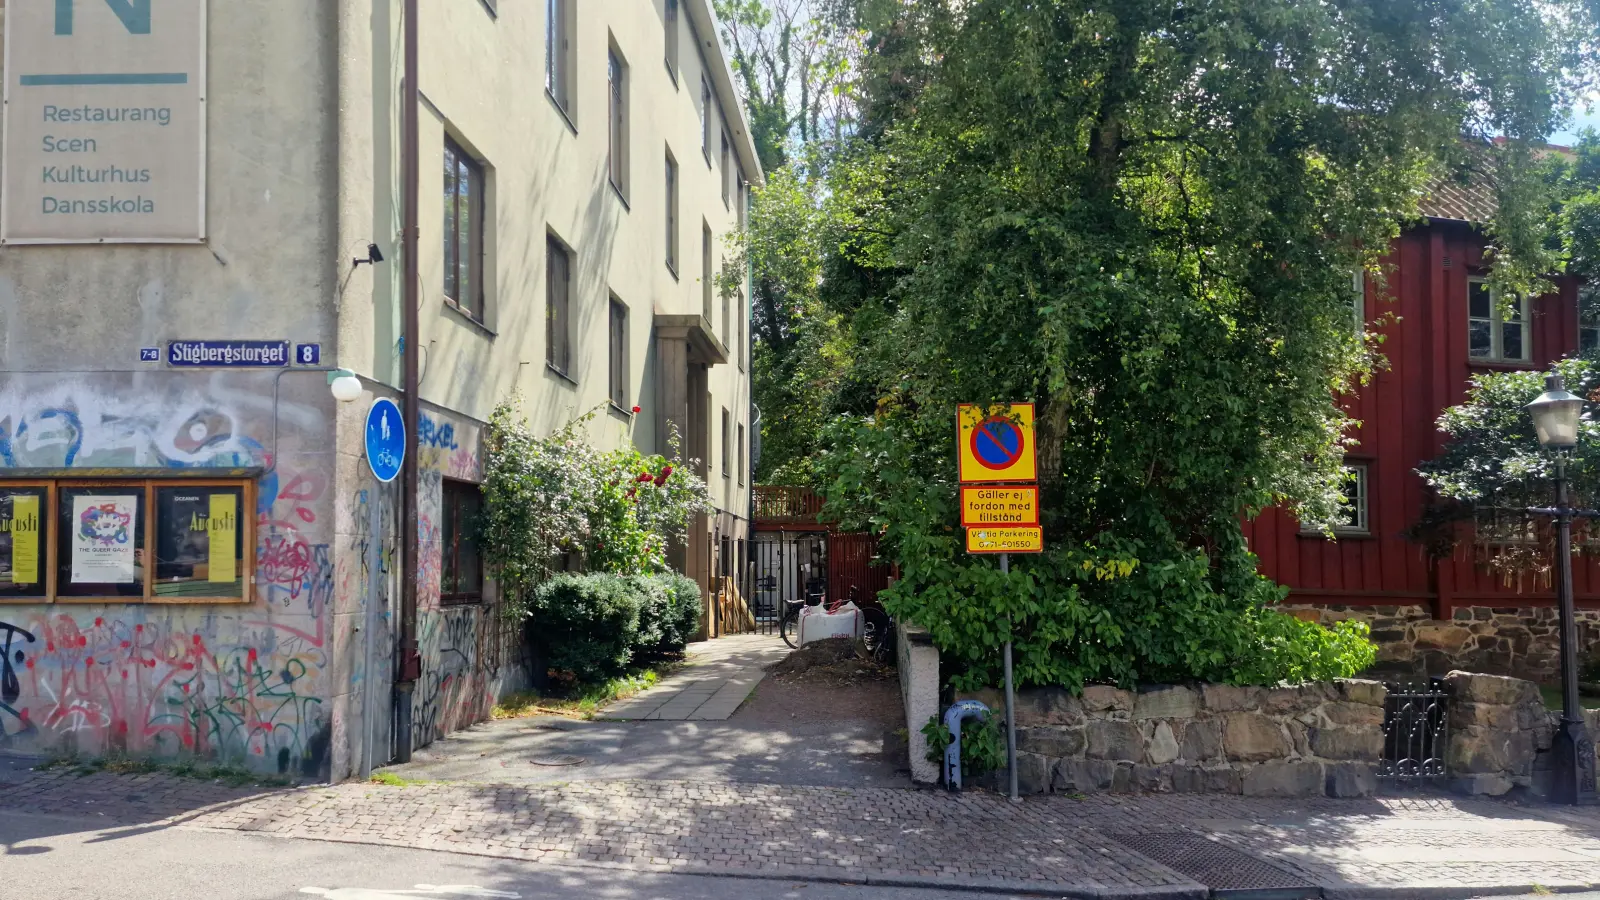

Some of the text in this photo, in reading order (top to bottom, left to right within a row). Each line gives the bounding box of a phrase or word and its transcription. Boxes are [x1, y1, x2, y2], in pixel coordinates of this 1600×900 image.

[43, 105, 171, 126] Restaurang
[42, 136, 97, 153] Scen
[42, 165, 151, 183] Kulturhus
[42, 196, 154, 214] Dansskola
[142, 350, 157, 359] 7-8
[172, 342, 284, 364] Stigbergstorget
[303, 346, 313, 362] 8
[978, 490, 1023, 501] Gäller ej
[970, 502, 1031, 510] fordon med
[0, 513, 37, 537] ugusti
[980, 513, 1022, 521] tillstånd
[1000, 530, 1038, 538] Parkering
